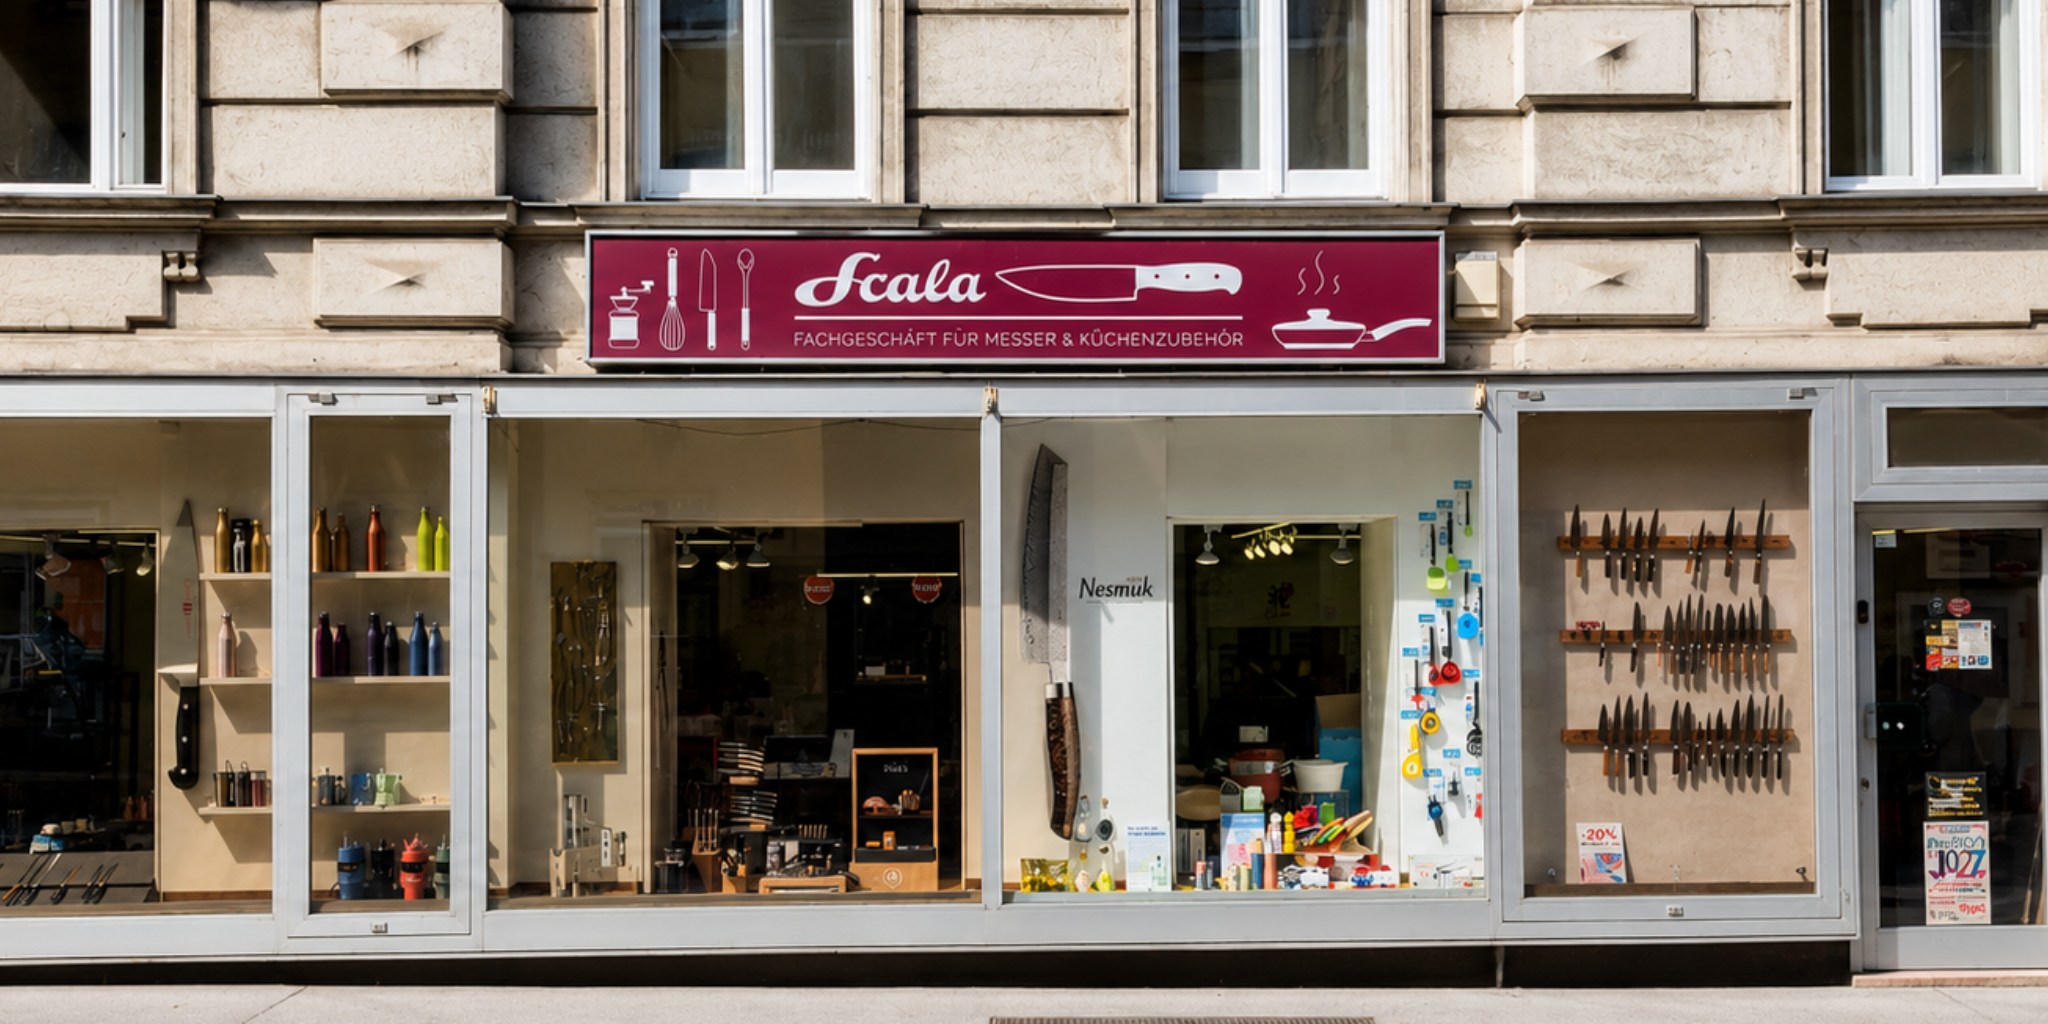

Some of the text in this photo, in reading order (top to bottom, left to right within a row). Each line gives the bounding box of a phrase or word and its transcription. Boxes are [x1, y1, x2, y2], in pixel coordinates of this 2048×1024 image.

[795, 252, 987, 307] Scala
[794, 328, 1243, 347] FACHGESCHÄFT FÜR MESSER & KÜCHENZUBEHÖR
[1079, 576, 1153, 599] Nesmuk
